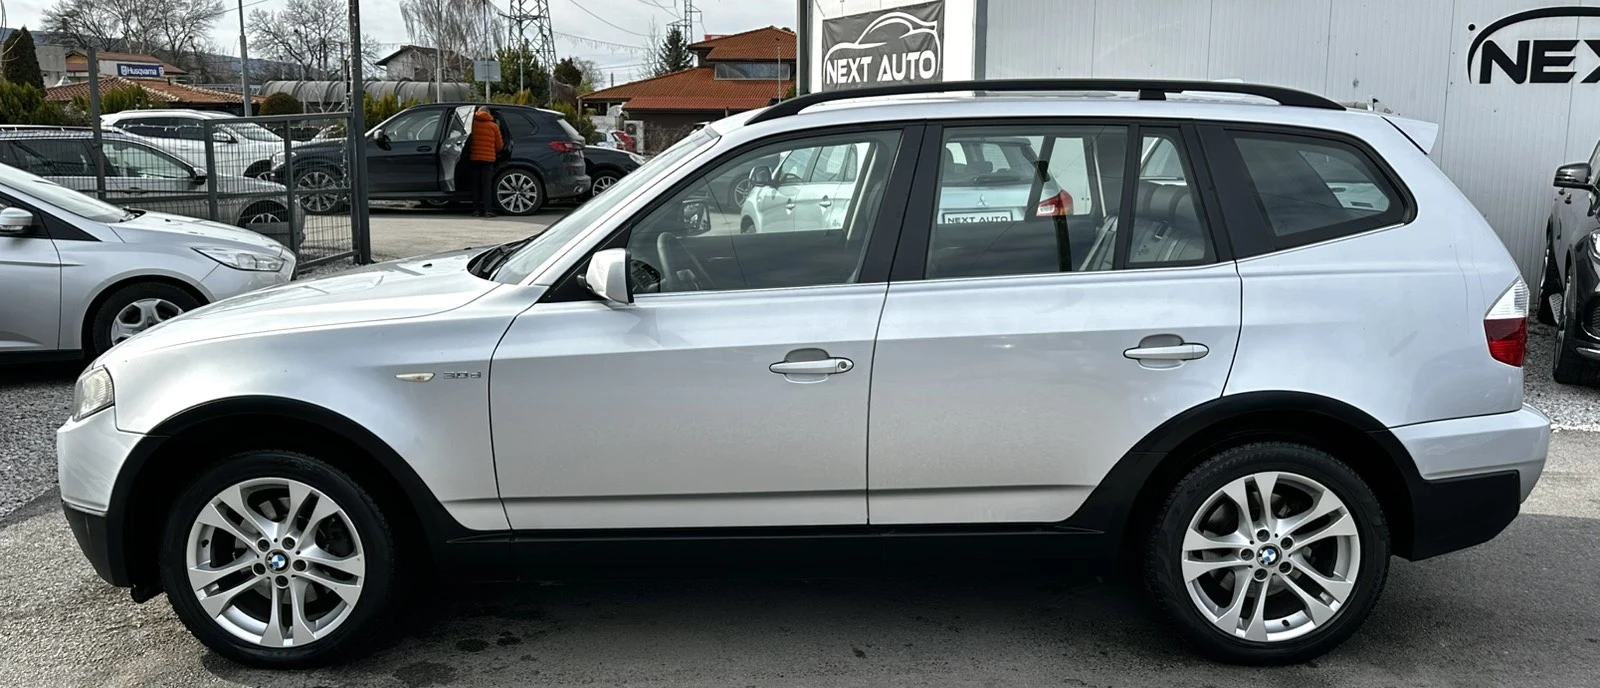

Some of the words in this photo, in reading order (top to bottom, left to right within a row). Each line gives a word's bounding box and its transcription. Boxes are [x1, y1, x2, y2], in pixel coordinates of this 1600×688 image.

[127, 66, 157, 76] Husqvarna
[827, 55, 873, 85] NEXT
[877, 50, 936, 82] AUTO
[947, 216, 976, 224] NEXT
[980, 215, 1008, 223] AUTO
